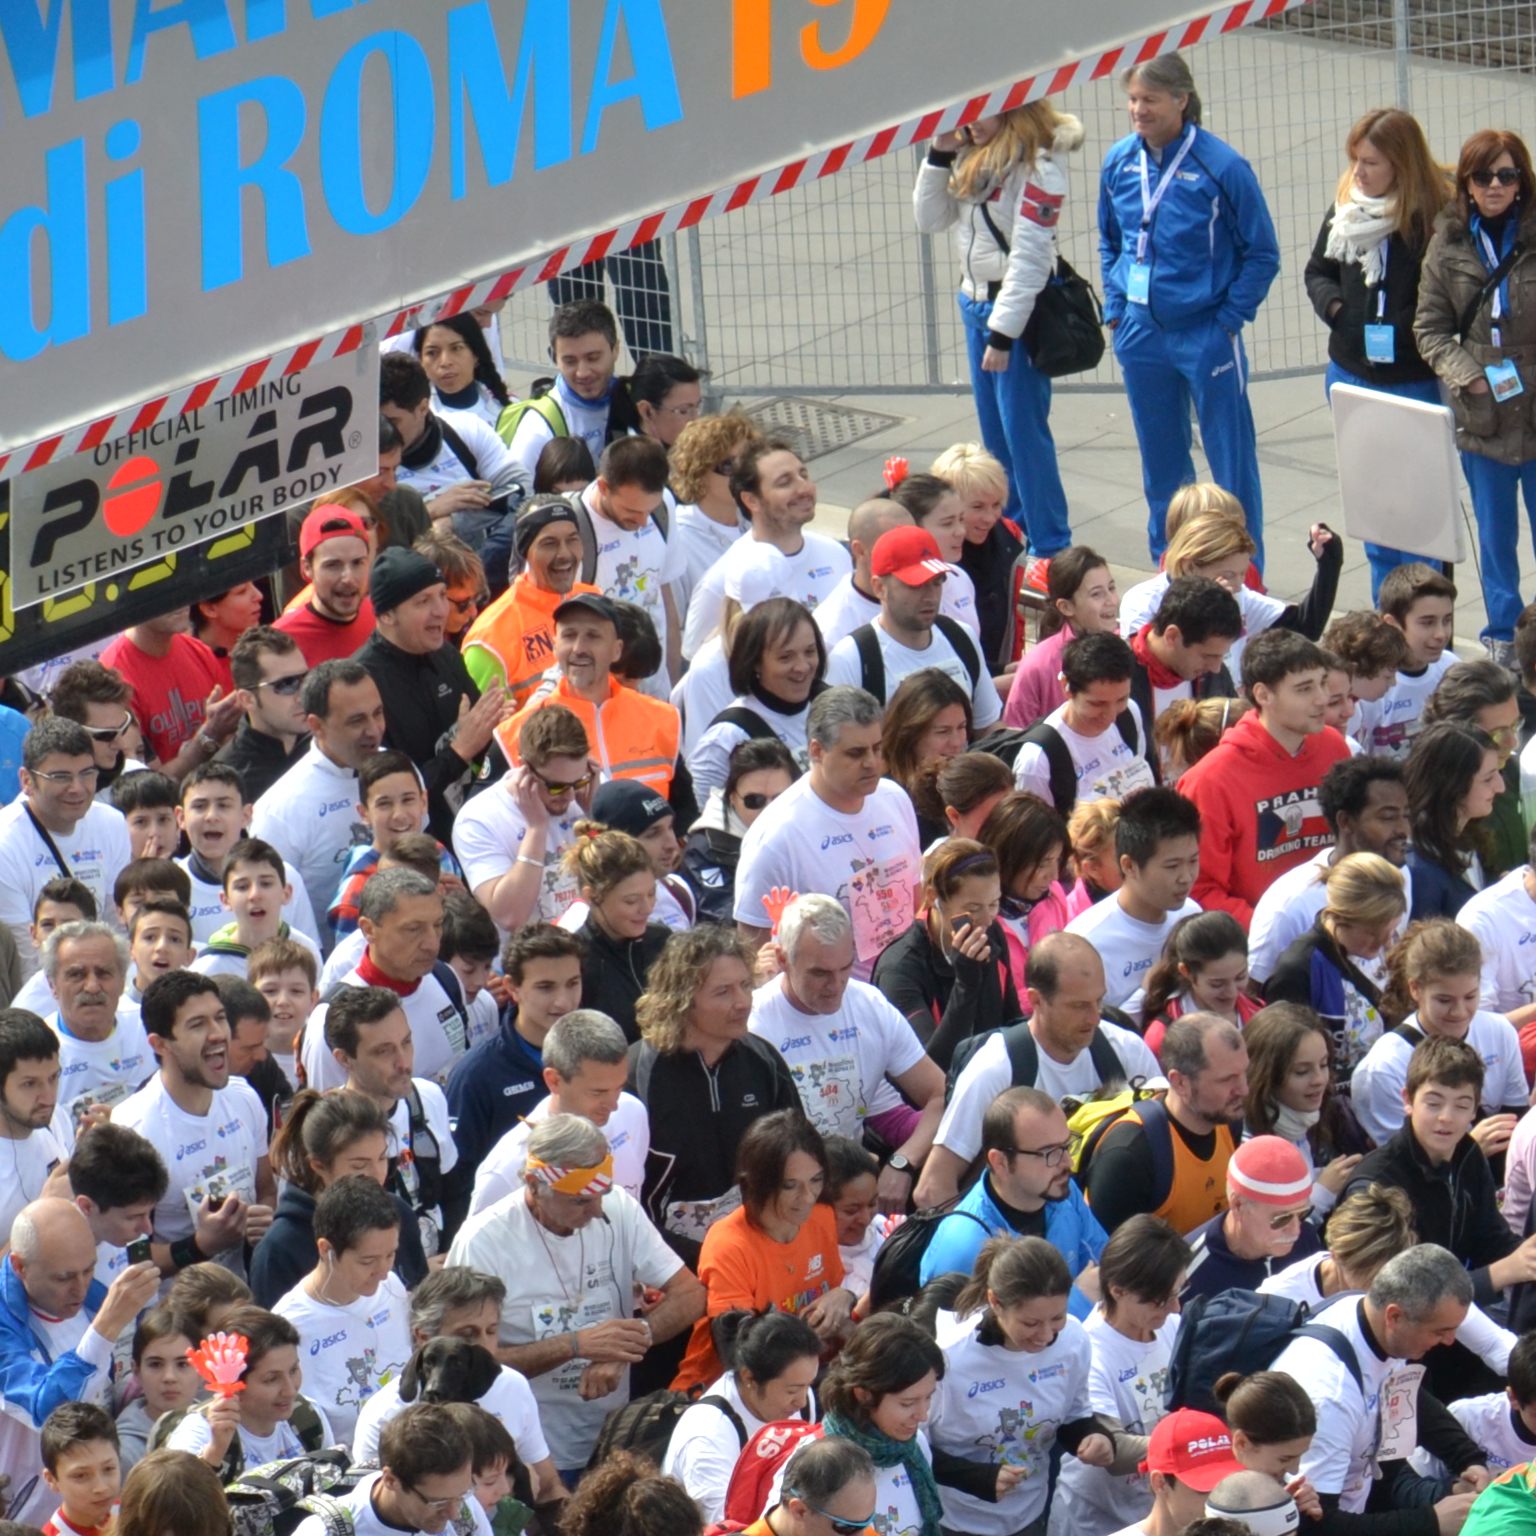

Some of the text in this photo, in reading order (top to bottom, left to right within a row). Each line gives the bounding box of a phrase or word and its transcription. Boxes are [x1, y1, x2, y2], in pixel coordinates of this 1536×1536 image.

[0, 118, 148, 362] di
[196, 0, 685, 293] ROMA
[93, 371, 302, 467] OFFICIAL TIMING
[30, 385, 353, 568] POLAR
[38, 463, 343, 594] LISTENS TO YOUR BODY
[831, 833, 852, 847] asics
[788, 1036, 810, 1048] asics
[184, 1139, 207, 1153] asics
[321, 1331, 346, 1350] asics
[979, 1379, 1004, 1393] asics
